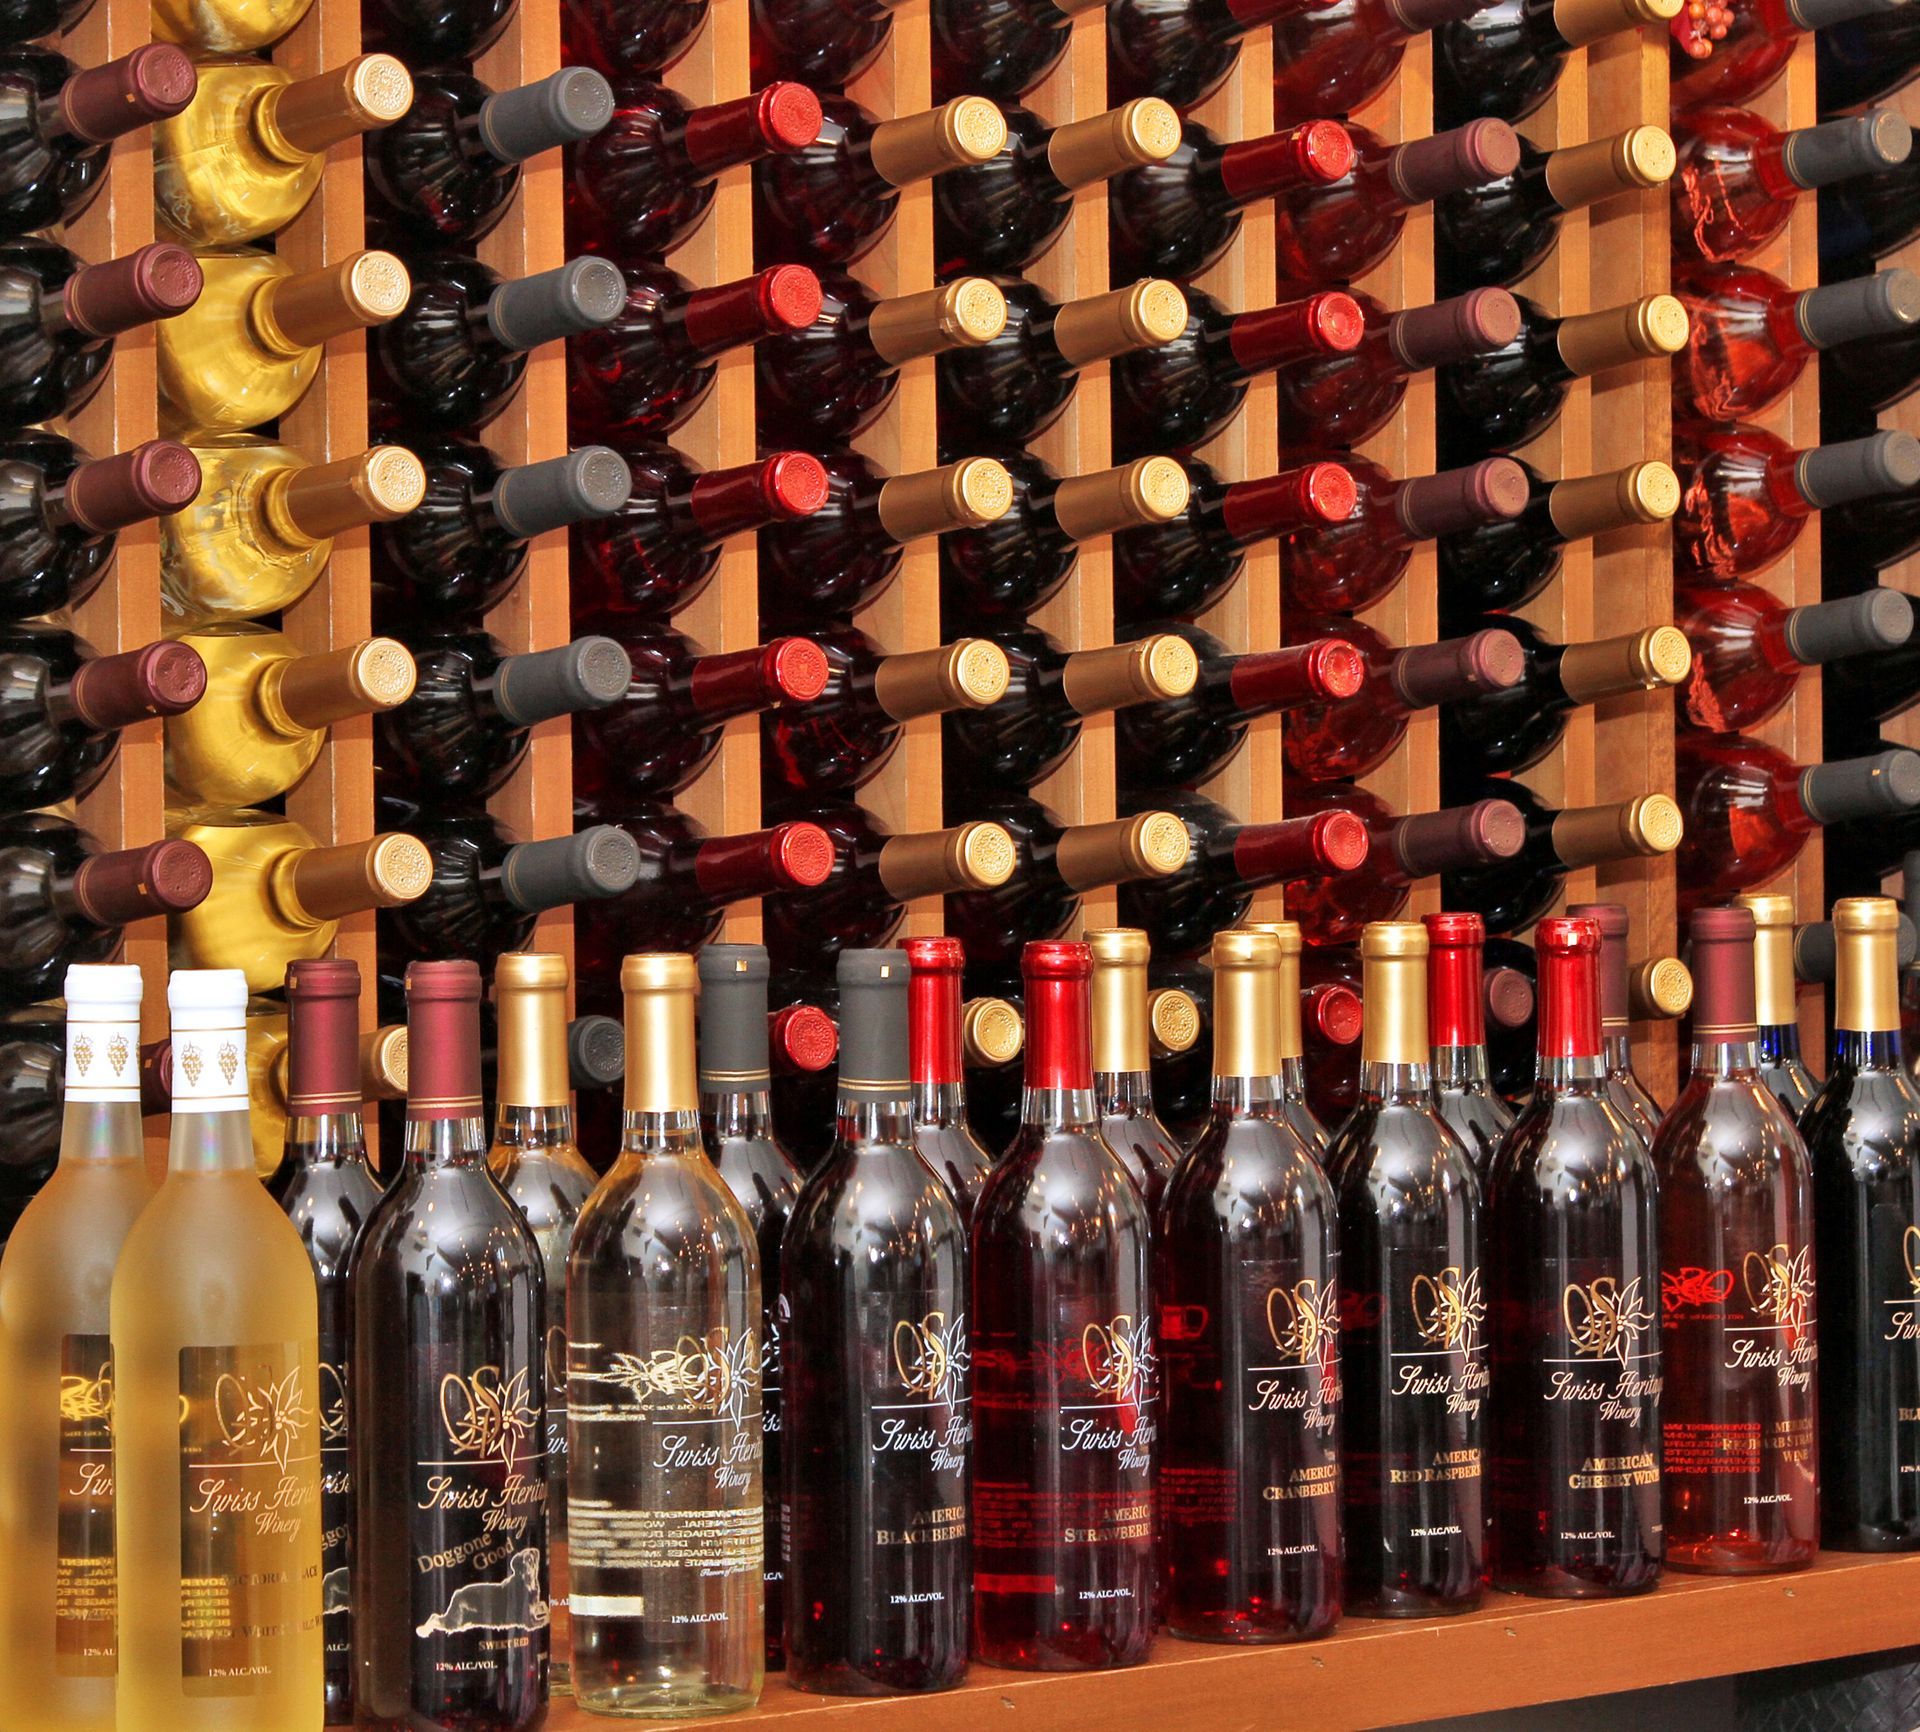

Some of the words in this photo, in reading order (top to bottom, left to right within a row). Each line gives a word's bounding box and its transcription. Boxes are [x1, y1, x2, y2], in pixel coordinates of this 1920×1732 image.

[1724, 1339, 1783, 1368] Swiss
[1391, 1365, 1452, 1395] Swiss
[1543, 1371, 1606, 1401] Swiss
[1777, 1365, 1811, 1393] Winery
[1248, 1380, 1308, 1411] Swiss
[1445, 1392, 1480, 1420] Winery
[1303, 1407, 1336, 1436] Winery
[1599, 1399, 1642, 1428] Winery
[872, 1418, 936, 1451] Swiss
[1061, 1419, 1123, 1450] Swiss
[653, 1435, 720, 1468] Swiss
[930, 1448, 965, 1478] Winery
[1118, 1447, 1151, 1477] Winery
[1581, 1452, 1654, 1472] AMERICAN
[714, 1465, 751, 1496] Winery
[1262, 1480, 1336, 1501] CRANBERRY
[1390, 1469, 1422, 1483] RED
[1568, 1472, 1632, 1489] CHERRY
[189, 1478, 261, 1512] Swiss
[418, 1475, 488, 1509] Swiss
[255, 1511, 301, 1542] Winery
[481, 1508, 527, 1539] Winery
[417, 1533, 492, 1573] Doggone
[472, 1536, 514, 1570] Good
[671, 1615, 689, 1624] 12%
[83, 1648, 101, 1656] 12%
[435, 1662, 453, 1671] 12%
[208, 1668, 226, 1677] 12%
